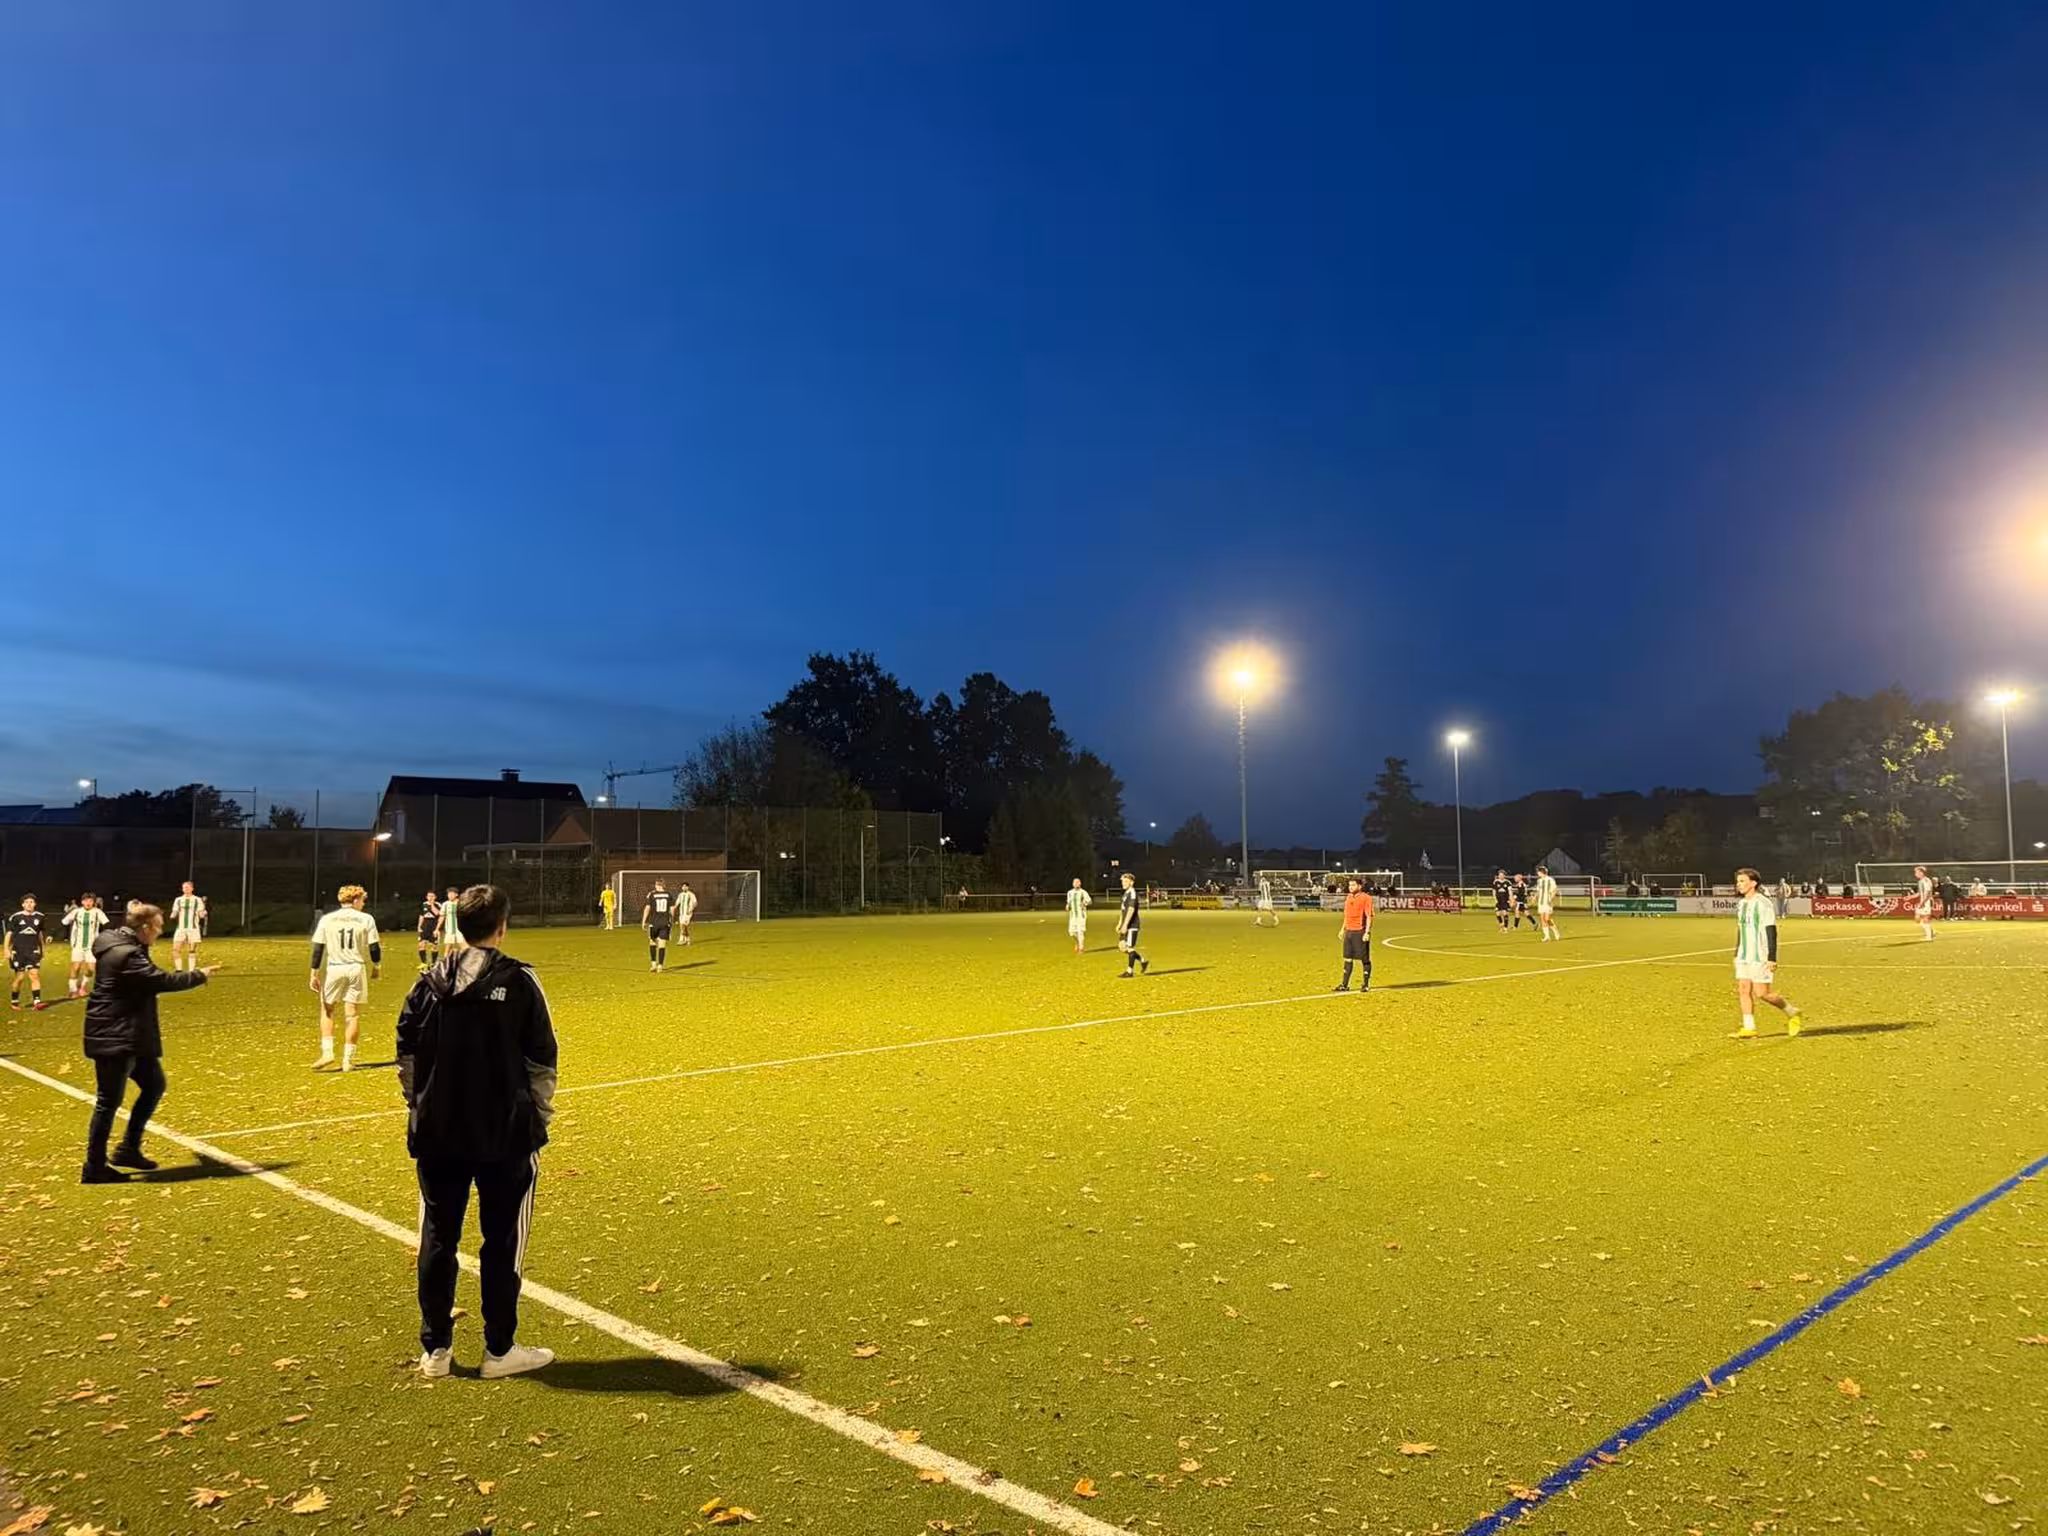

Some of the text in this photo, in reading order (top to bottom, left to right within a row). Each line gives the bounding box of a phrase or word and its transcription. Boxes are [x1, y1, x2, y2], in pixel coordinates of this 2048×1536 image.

[655, 898, 668, 912] 10
[1380, 897, 1415, 908] REWE
[1712, 900, 1738, 909] Hohe
[338, 927, 354, 950] 11
